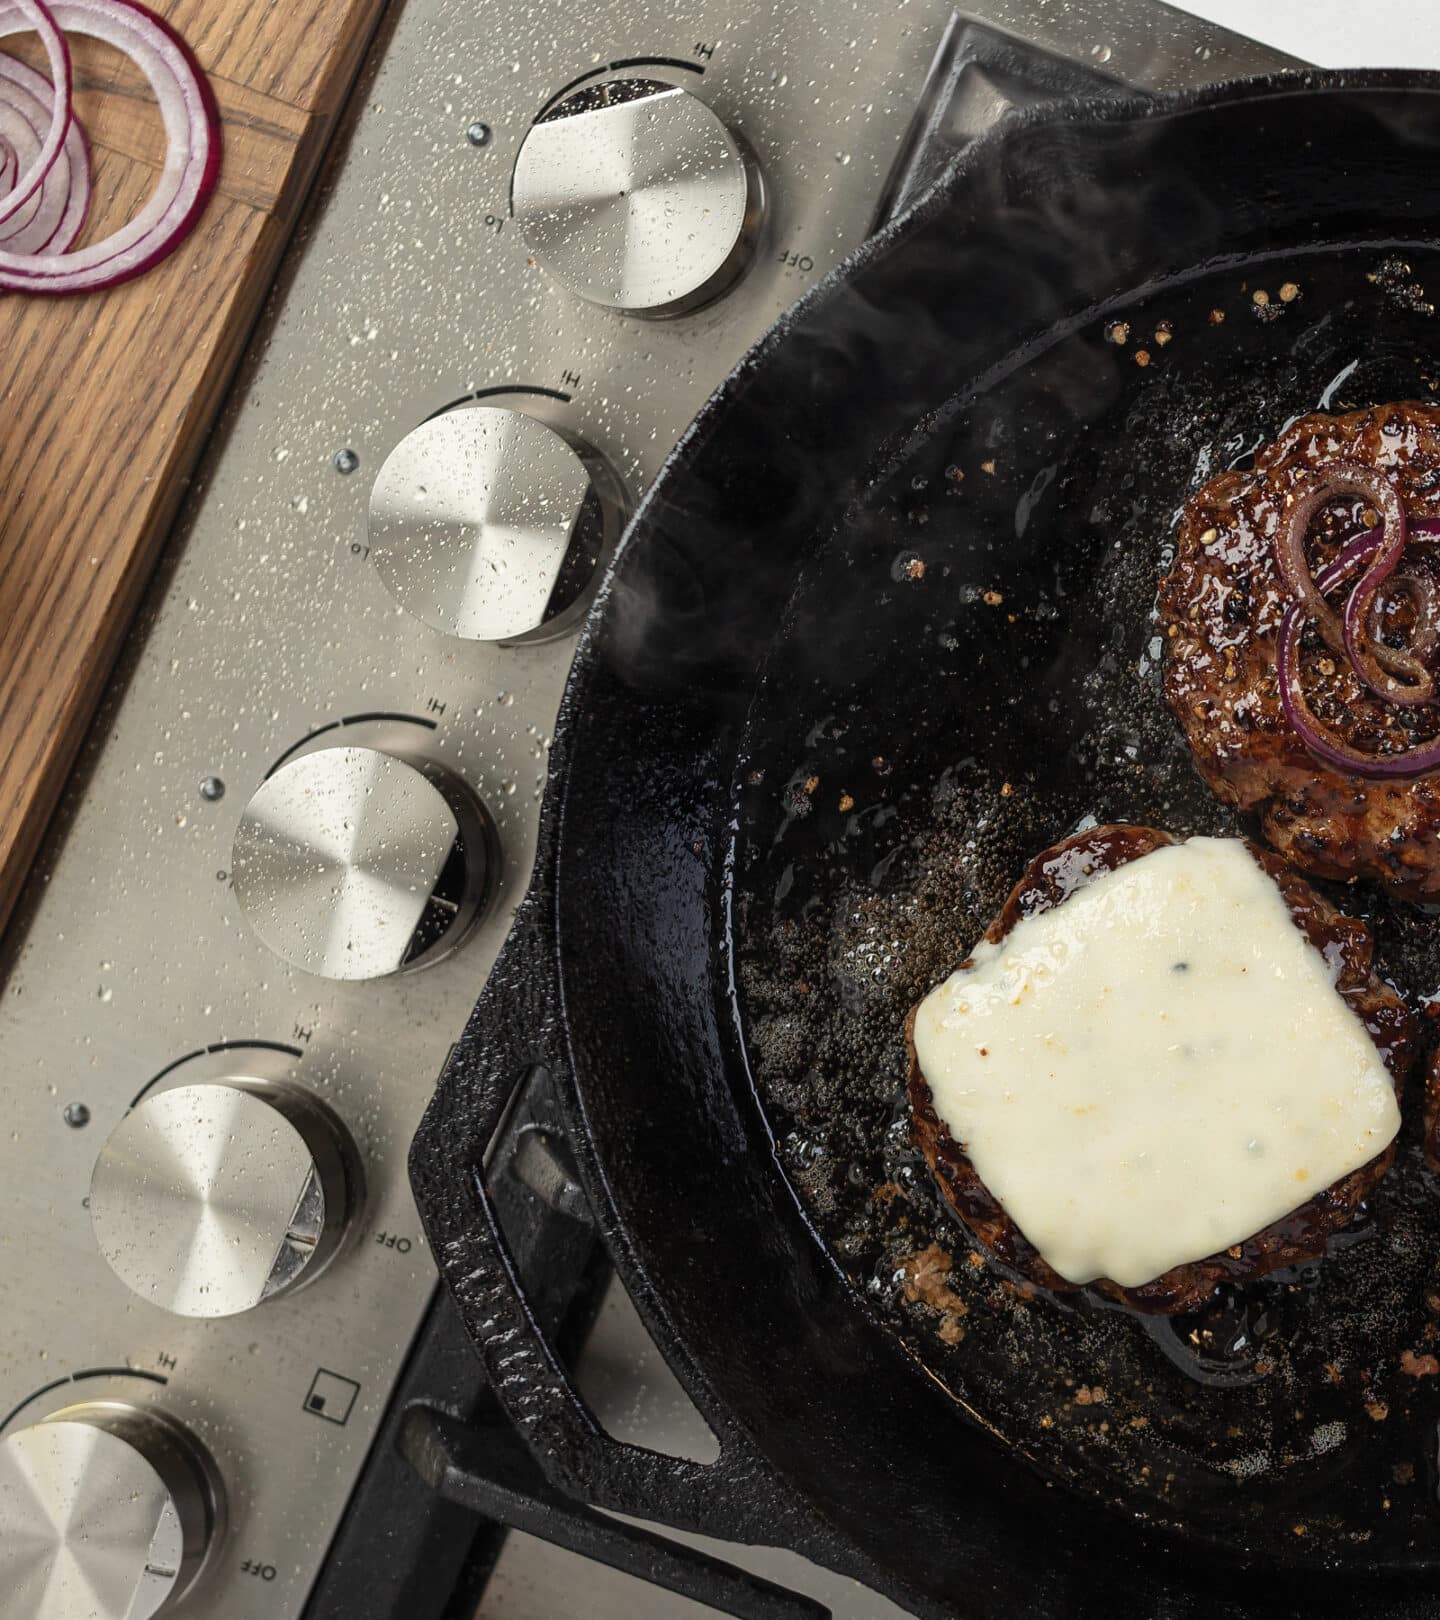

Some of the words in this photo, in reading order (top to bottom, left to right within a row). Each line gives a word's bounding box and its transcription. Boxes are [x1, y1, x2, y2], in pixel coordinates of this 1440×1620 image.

[485, 215, 504, 233] Lo
[776, 250, 814, 272] OFF
[561, 369, 581, 388] Hi
[426, 697, 446, 716] Hi
[376, 1232, 411, 1253] OFF
[158, 1352, 177, 1370] Hi
[240, 1559, 277, 1581] OFF
